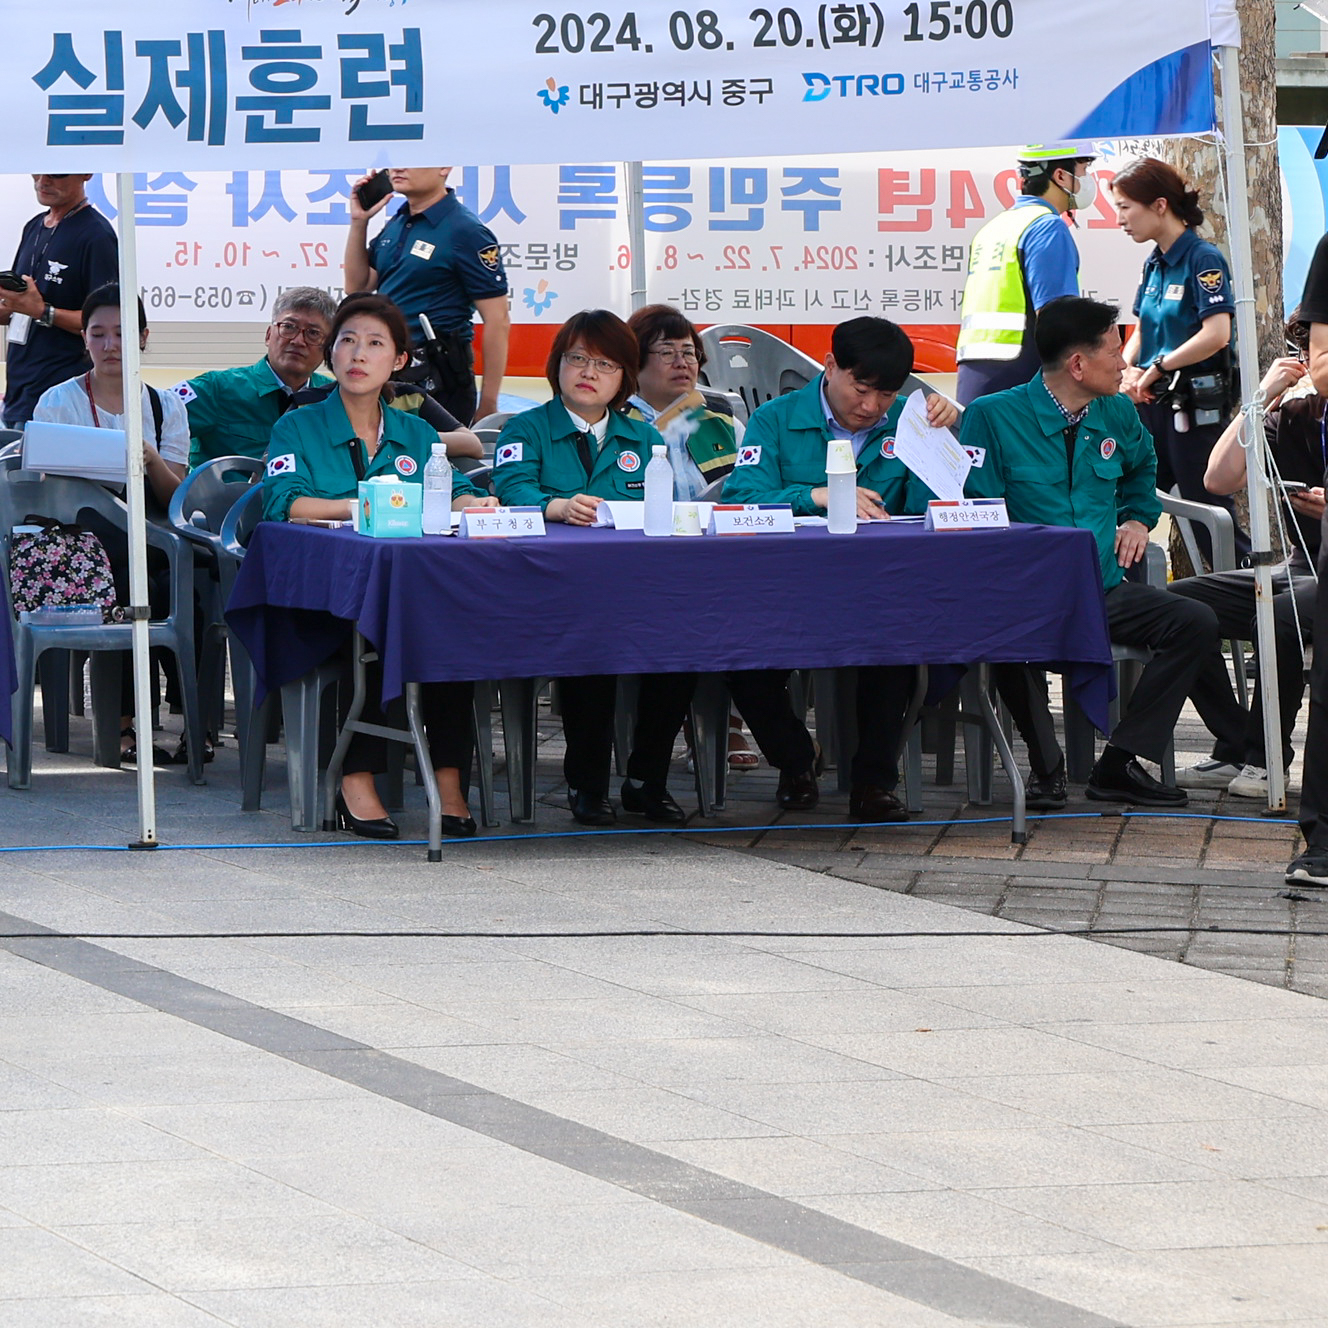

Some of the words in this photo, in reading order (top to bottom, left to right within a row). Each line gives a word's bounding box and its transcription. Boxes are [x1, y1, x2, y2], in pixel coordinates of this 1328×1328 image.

[532, 11, 654, 55] 2024.
[669, 9, 735, 53] 08.
[749, 1, 885, 50] 20.(화)
[31, 26, 426, 148] 실제훈련
[578, 79, 712, 110] 대구광역시
[721, 77, 775, 108] 중구
[800, 71, 905, 103] DTRO
[913, 67, 1019, 95] 대구교통공사
[732, 513, 776, 527] 보건소장
[937, 508, 1000, 523] 행정안전국장
